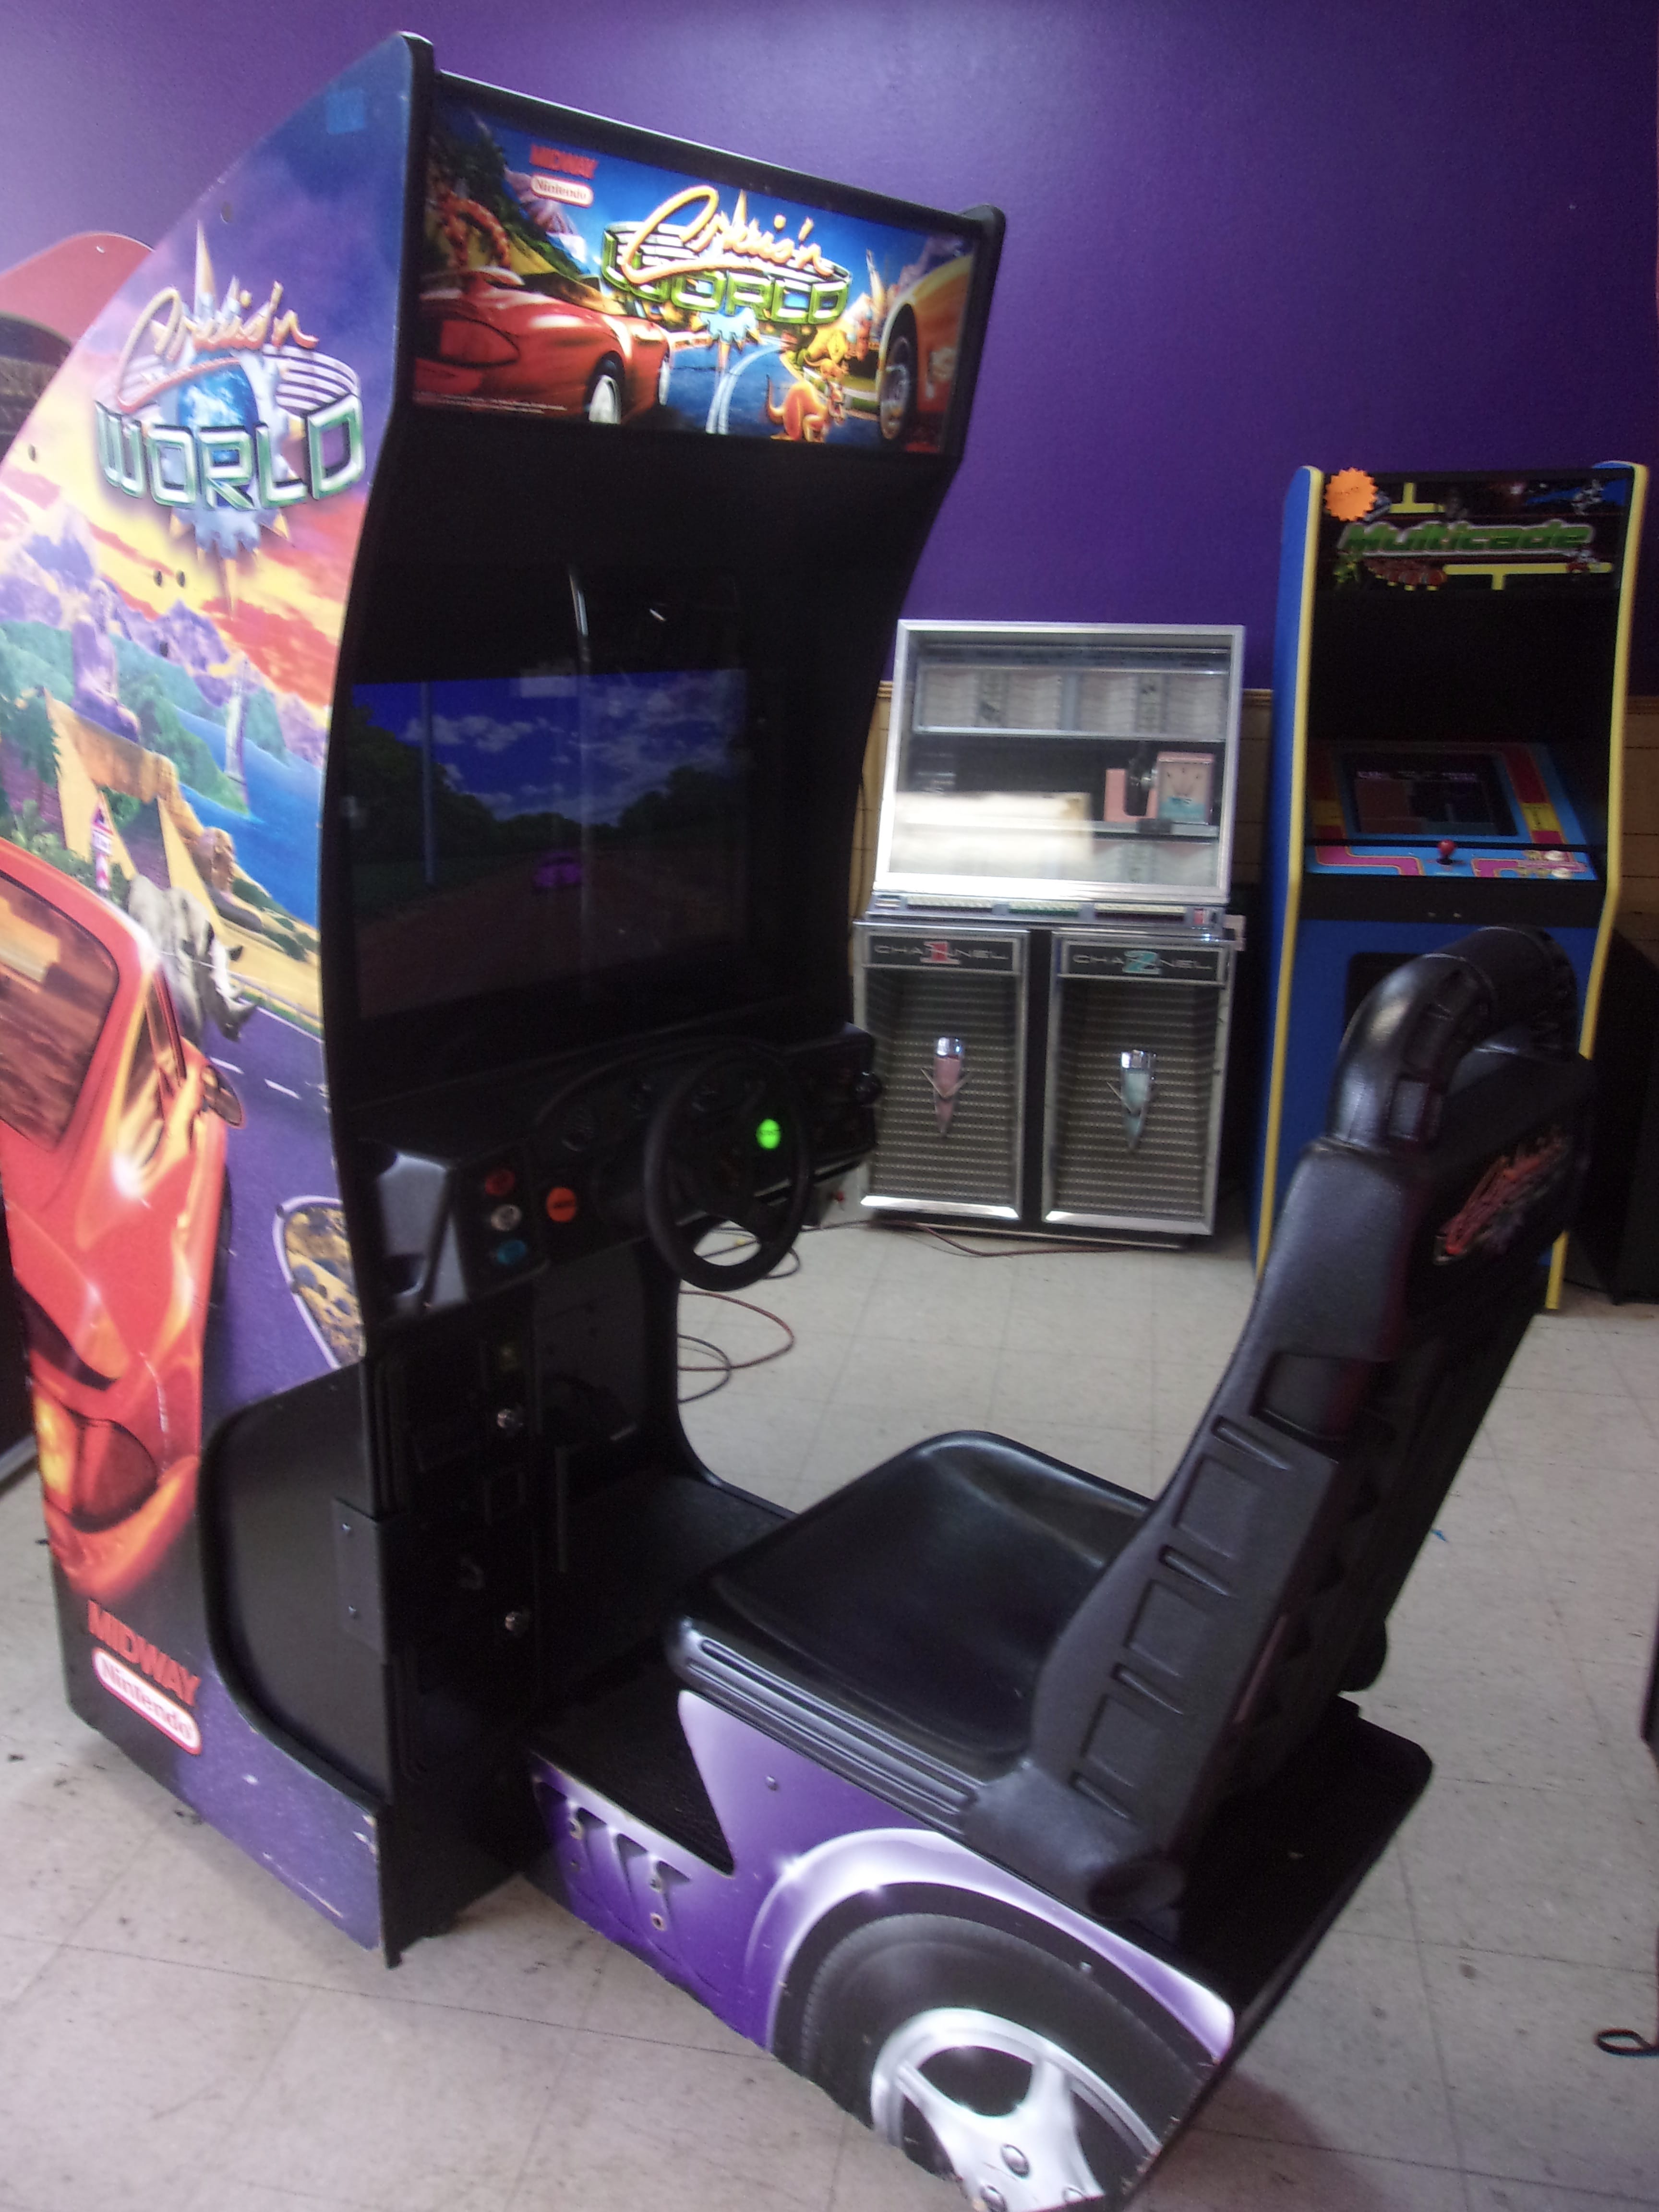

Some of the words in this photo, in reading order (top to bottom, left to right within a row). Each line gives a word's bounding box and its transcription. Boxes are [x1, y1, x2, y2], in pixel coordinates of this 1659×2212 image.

[536, 178, 587, 200] Nintendo
[601, 229, 849, 325] WORLD
[96, 394, 365, 510] WORLD
[99, 1658, 191, 1740] Nintendo
